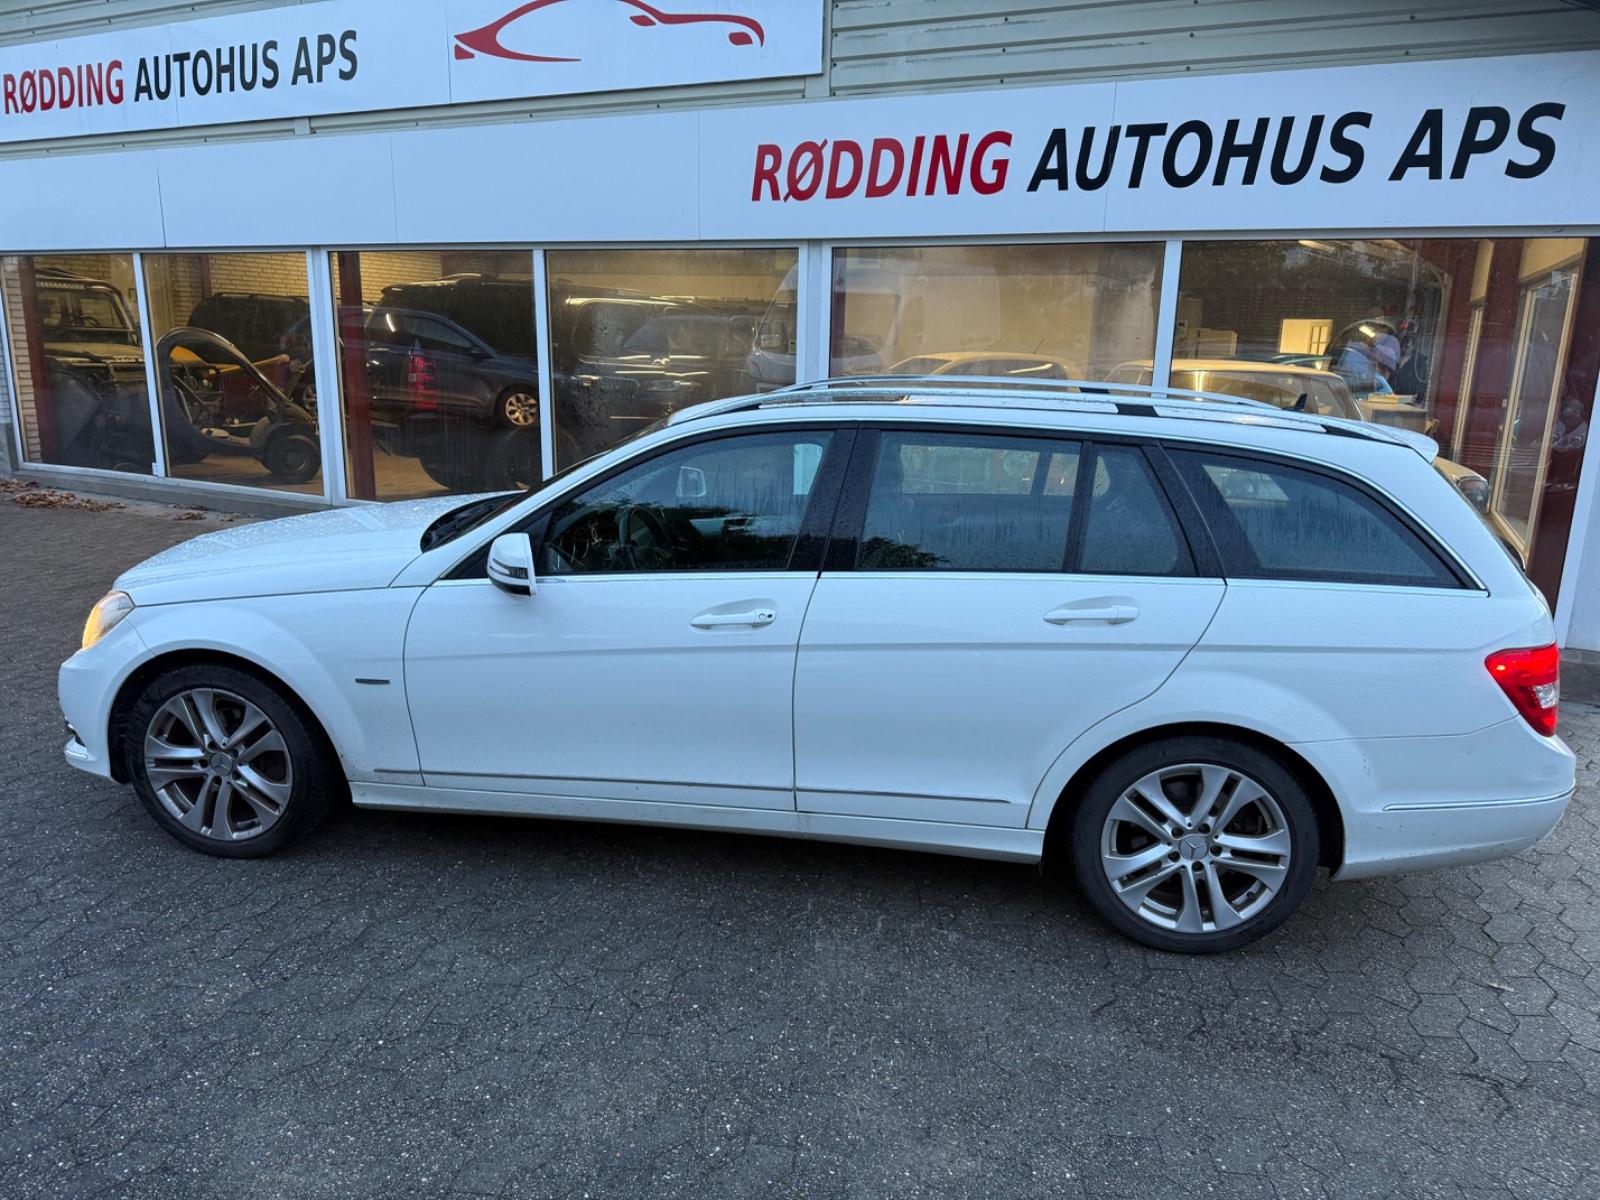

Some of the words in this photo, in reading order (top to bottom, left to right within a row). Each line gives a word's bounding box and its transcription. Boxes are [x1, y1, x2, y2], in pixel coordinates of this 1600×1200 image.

[4, 60, 124, 114] RØDDING
[134, 40, 280, 102] AUTOHUS
[291, 30, 358, 85] APS
[752, 130, 1013, 204] RØDDING
[1027, 111, 1373, 194] AUTOHUS
[1388, 101, 1566, 183] APS
